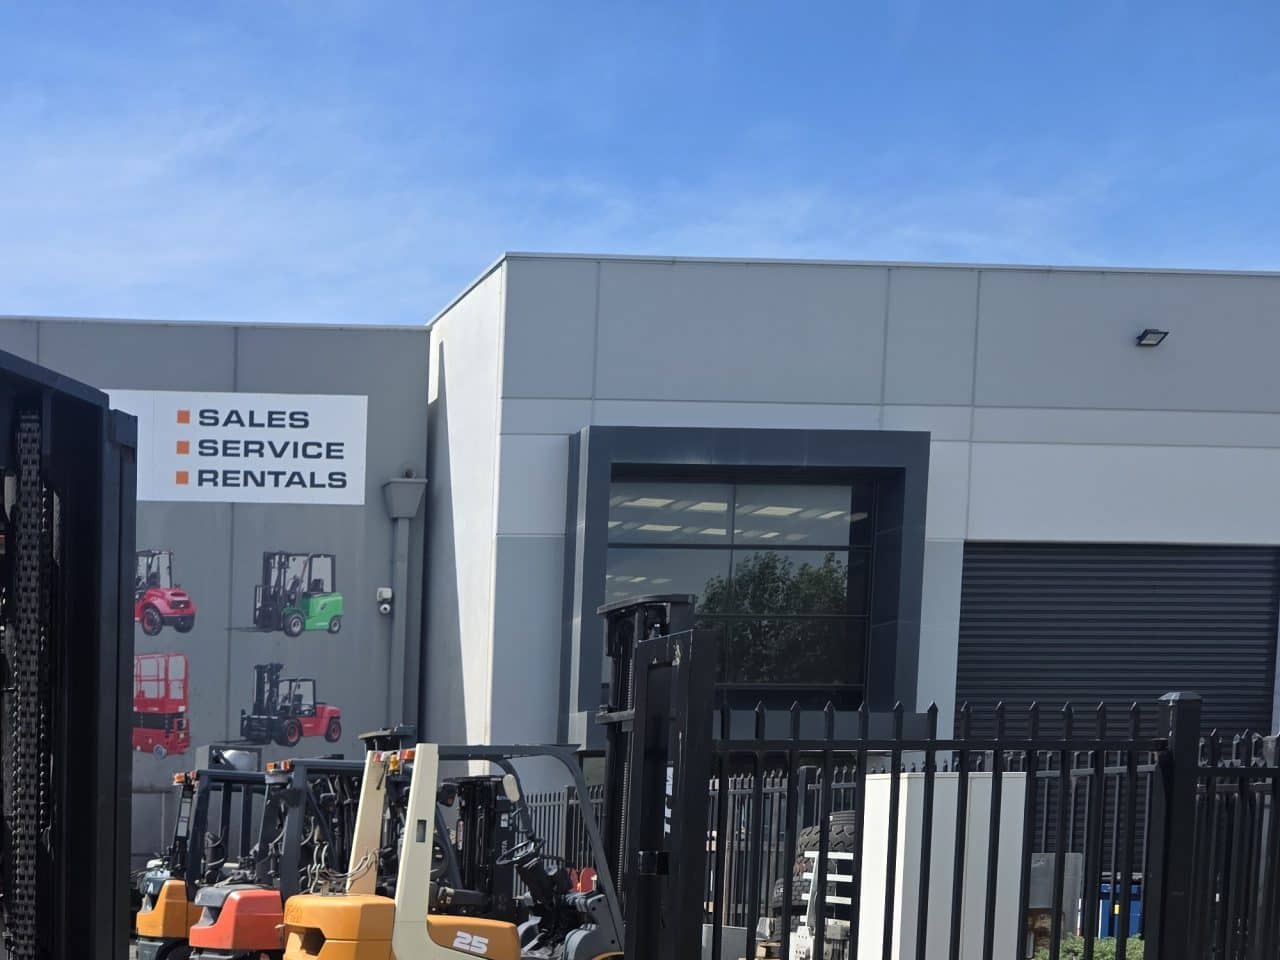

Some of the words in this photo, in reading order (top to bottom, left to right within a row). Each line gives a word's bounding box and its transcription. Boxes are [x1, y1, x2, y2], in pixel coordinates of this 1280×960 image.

[198, 409, 310, 429] SALES
[198, 439, 345, 460] SERVICE
[197, 469, 347, 489] RENTALS
[452, 930, 489, 955] 25
